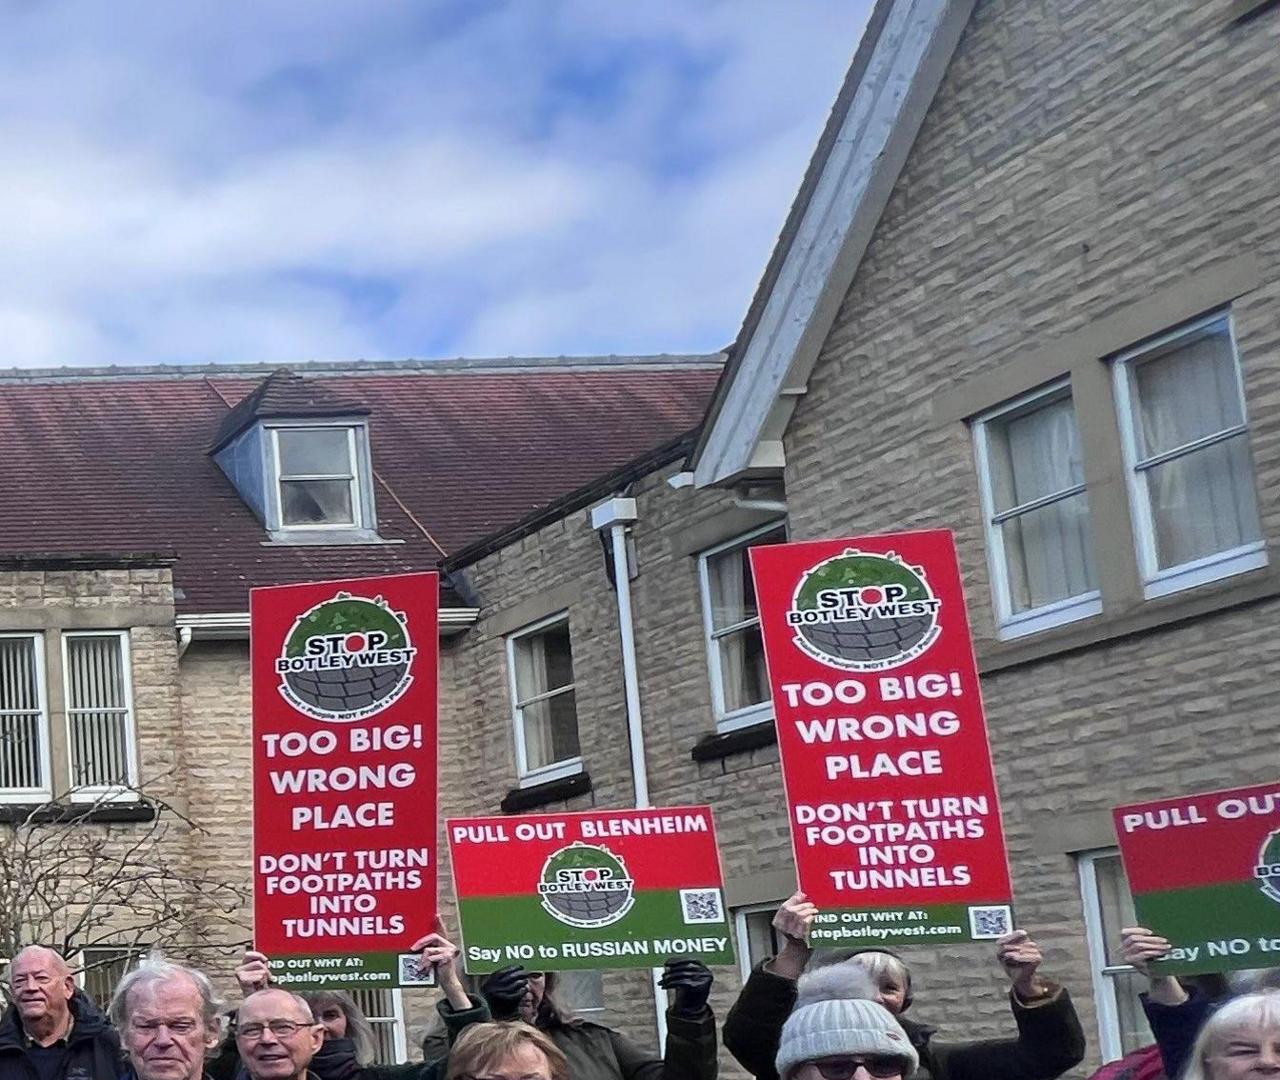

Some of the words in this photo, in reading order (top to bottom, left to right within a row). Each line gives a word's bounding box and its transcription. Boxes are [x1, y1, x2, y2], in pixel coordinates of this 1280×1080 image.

[782, 679, 866, 707] TOO
[880, 672, 963, 700] BIG!
[262, 731, 336, 757] TOO
[350, 725, 422, 753] BIG!
[795, 711, 960, 744] WRONG
[826, 750, 942, 780] PLACE
[271, 764, 415, 794] WRONG
[292, 803, 394, 831] PLACE
[796, 800, 895, 825] DON'T
[902, 796, 988, 817] TURN
[1123, 806, 1207, 833] PULL
[453, 827, 509, 843] PULL
[516, 823, 565, 840] OUT
[581, 814, 707, 838] BLENHEIM
[806, 818, 984, 847] FOOTPATHS
[260, 851, 347, 874] DON'T
[354, 848, 428, 868] TURN
[858, 844, 935, 866] INTO
[266, 870, 421, 894] FOOTPATHS
[829, 866, 971, 890] TUNNELS
[310, 894, 376, 914] INTO
[284, 916, 404, 937] TUNNELS
[469, 946, 501, 962] Say
[506, 945, 534, 960] NO
[539, 946, 558, 958] to
[562, 941, 649, 958] RUSSIAN
[654, 938, 727, 954] MONEY
[1207, 938, 1250, 956] NO
